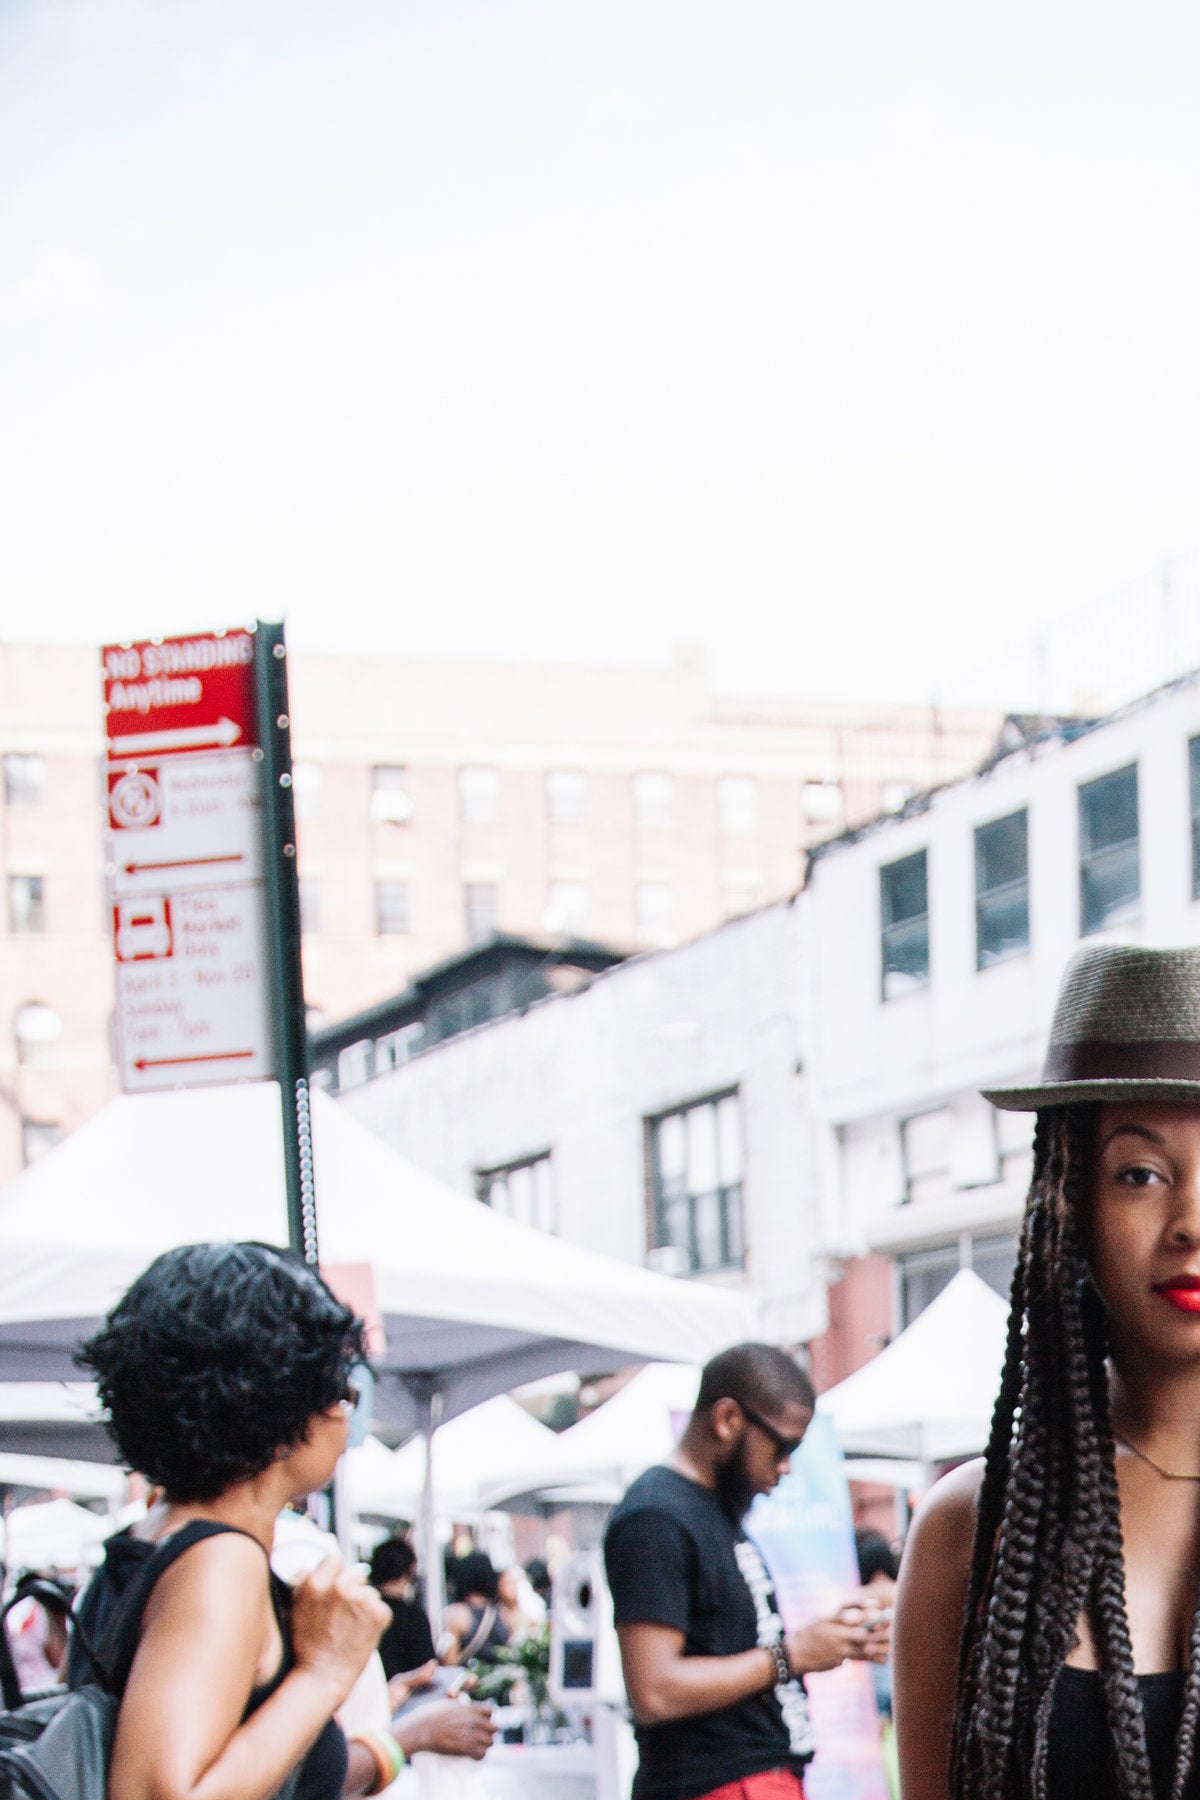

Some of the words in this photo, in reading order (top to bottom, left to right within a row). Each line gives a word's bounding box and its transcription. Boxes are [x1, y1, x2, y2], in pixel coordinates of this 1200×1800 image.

[107, 649, 140, 679] NO
[142, 634, 253, 676] STANDING
[110, 675, 203, 714] Anytime
